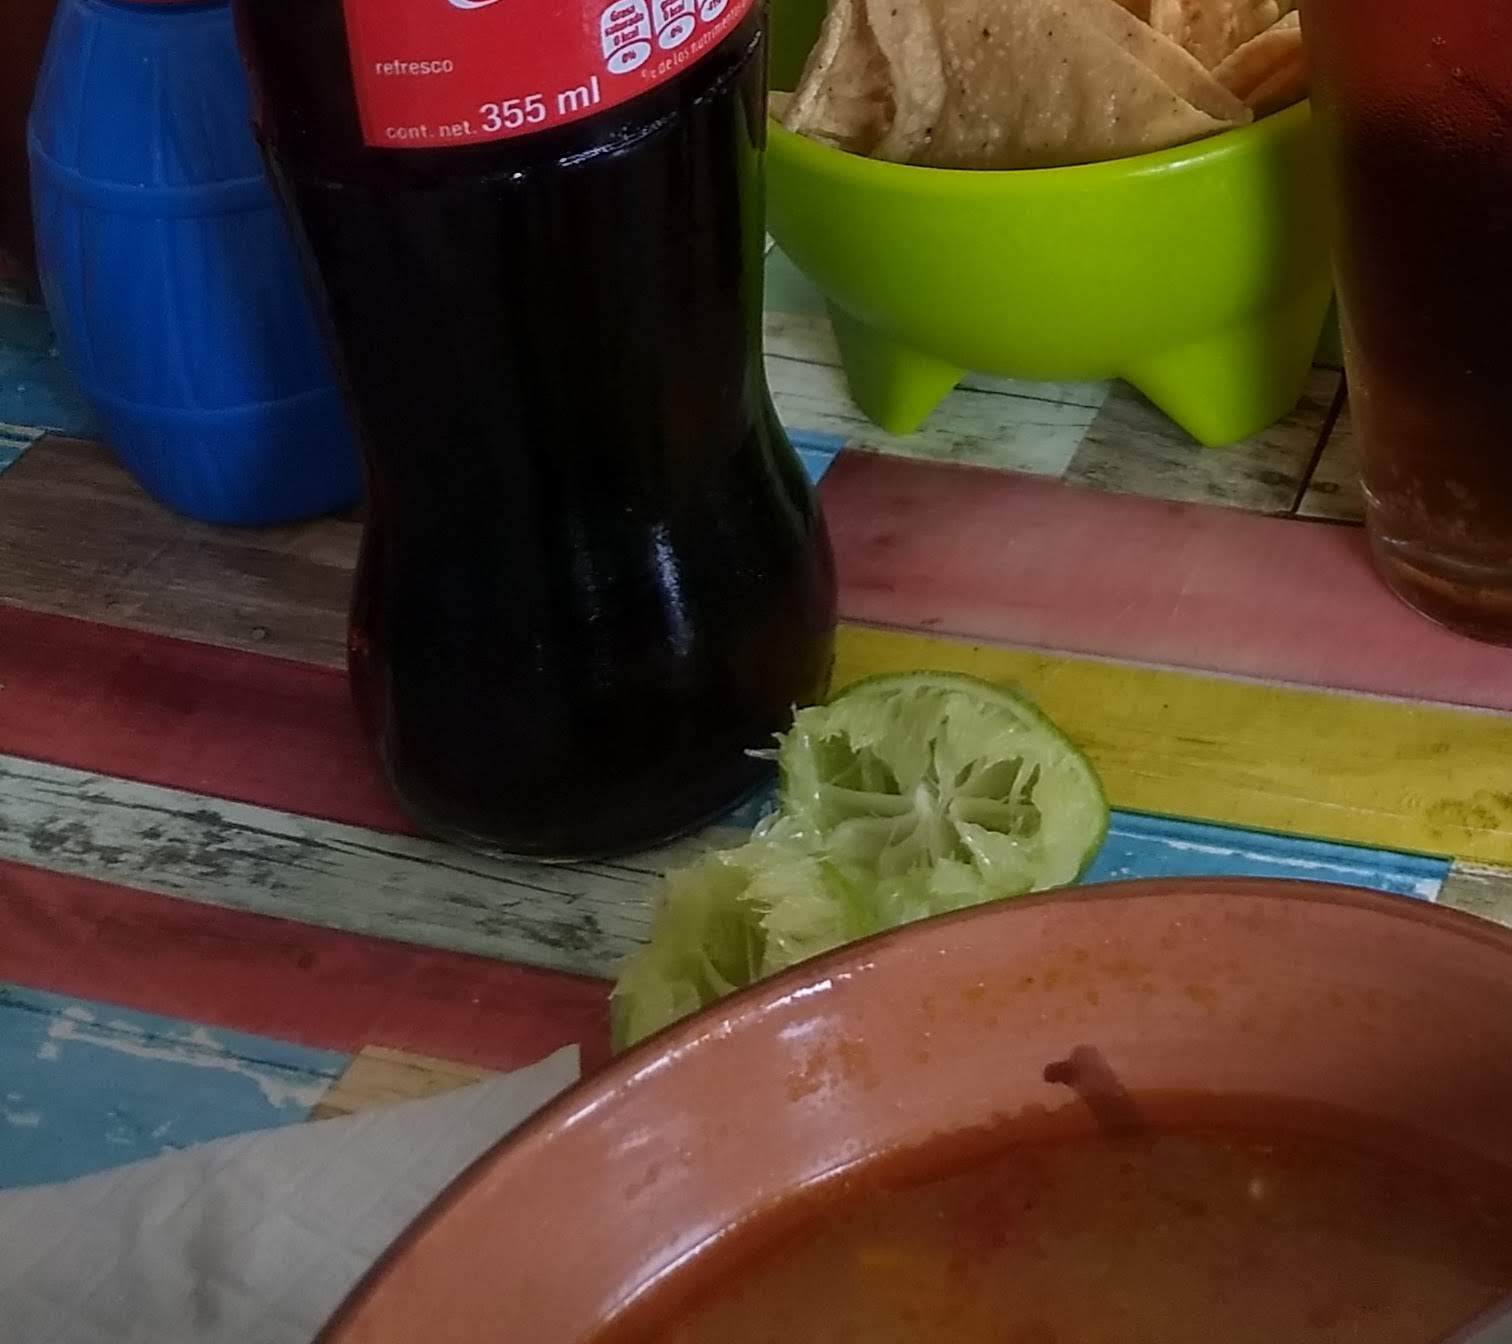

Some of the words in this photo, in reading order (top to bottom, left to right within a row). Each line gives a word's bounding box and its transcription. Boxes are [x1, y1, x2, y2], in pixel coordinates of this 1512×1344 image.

[375, 59, 454, 76] refresco
[385, 125, 434, 140] cont.
[438, 120, 477, 138] net.
[479, 92, 547, 133] 355
[556, 75, 601, 116] ml
